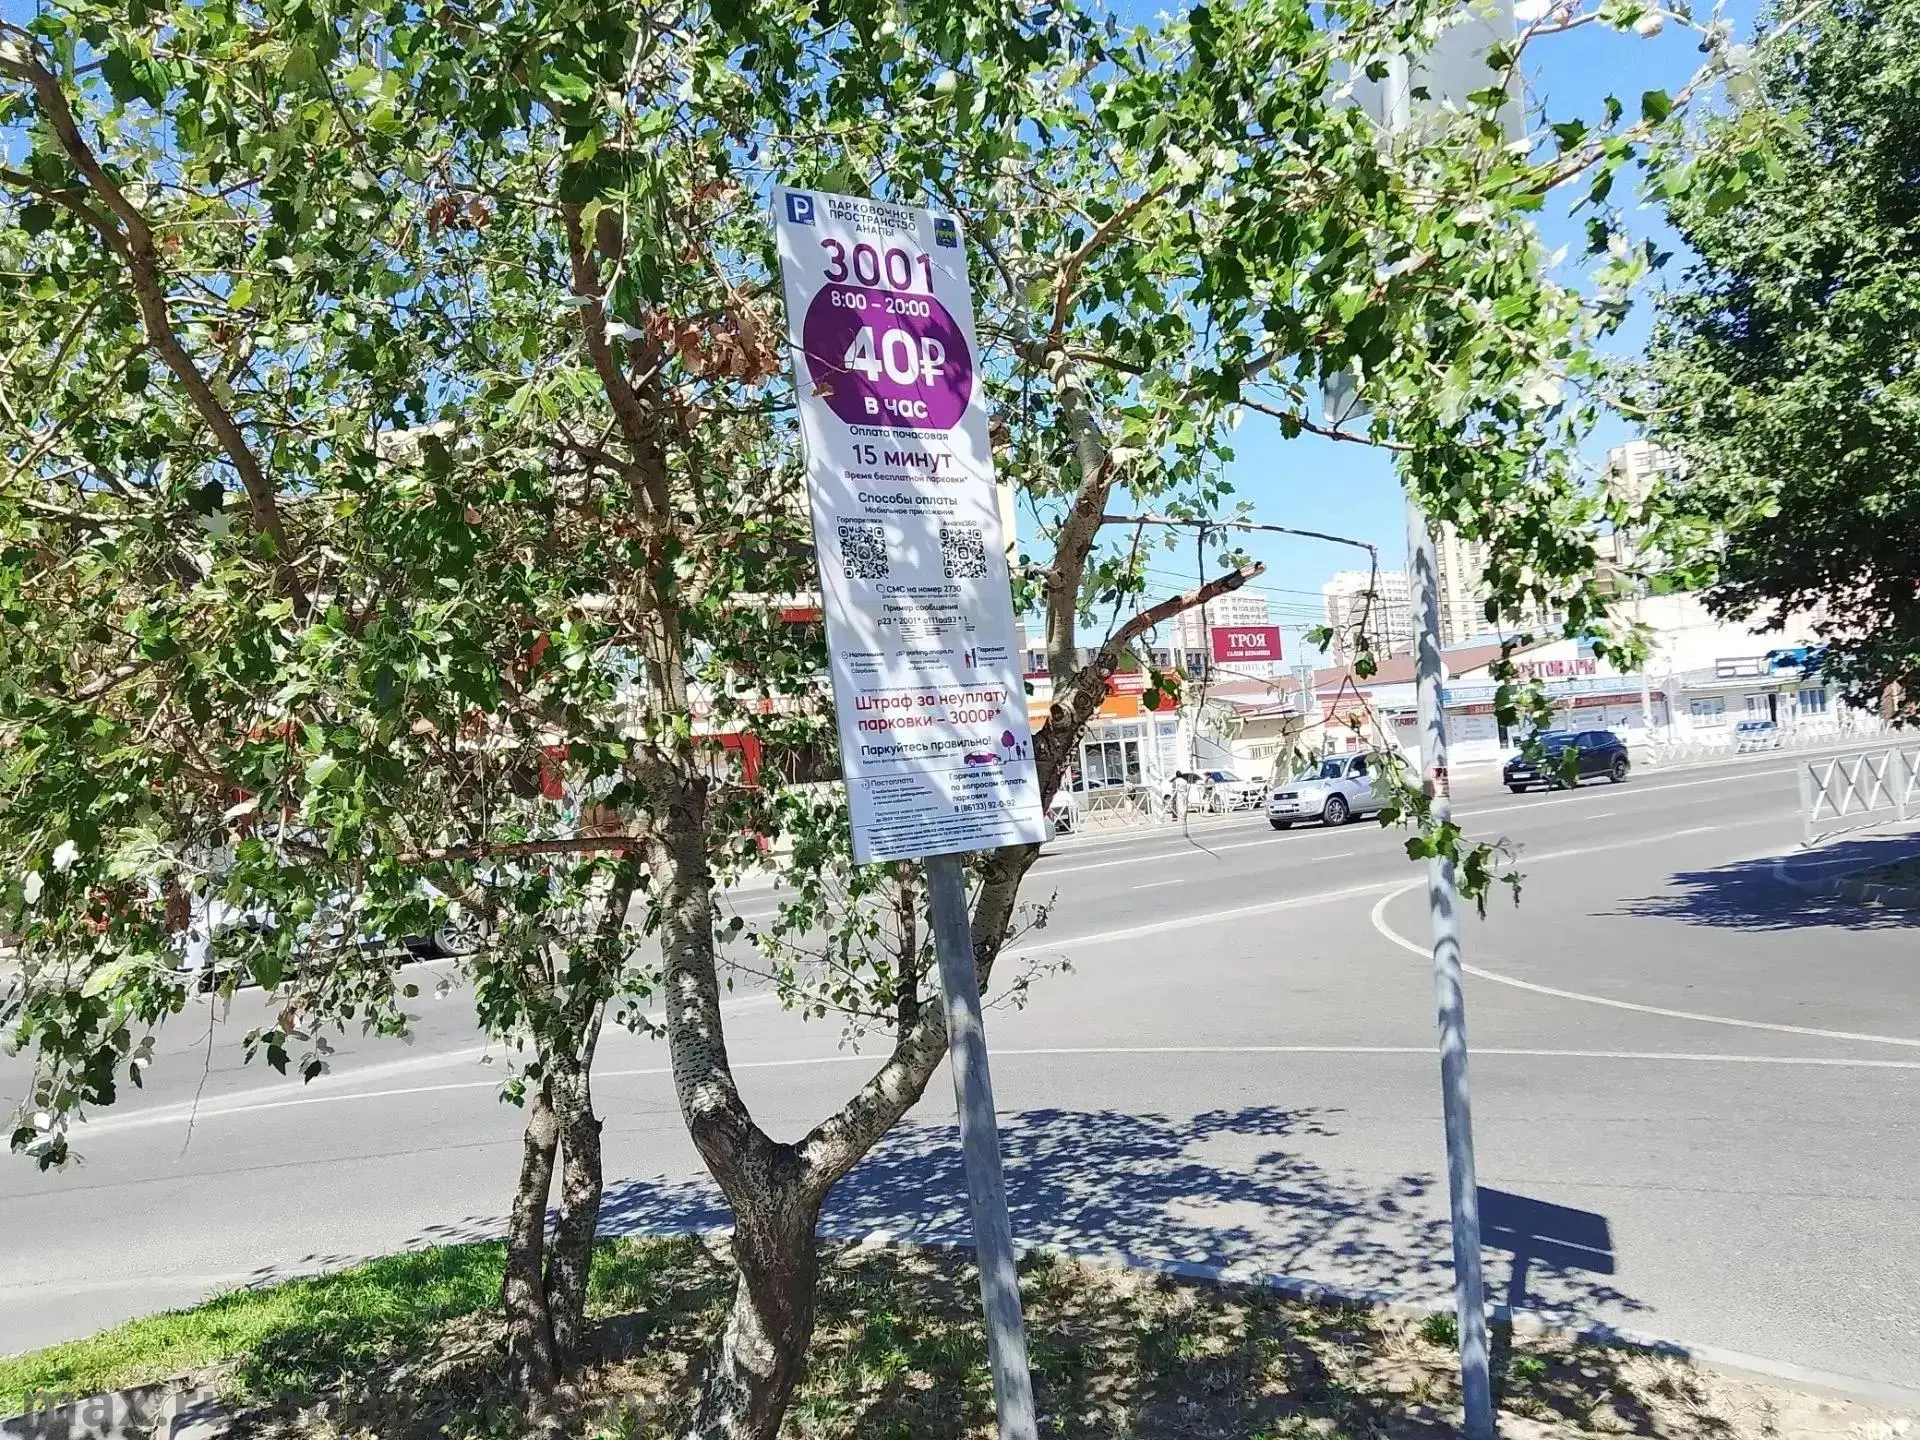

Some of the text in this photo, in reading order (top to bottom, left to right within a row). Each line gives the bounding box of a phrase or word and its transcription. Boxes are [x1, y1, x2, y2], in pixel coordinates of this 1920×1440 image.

[828, 199, 915, 222] ПАРКОВОЧНОЕ
[829, 210, 917, 232] ПРОСТРАНСТВО
[855, 224, 895, 238] АНАПЫ
[820, 238, 935, 294] 3001
[830, 290, 868, 310] 8:00
[884, 297, 931, 318] 20:00
[844, 325, 947, 387] 40₽
[863, 396, 929, 419] в час
[849, 425, 949, 442] Оплата почасовая
[851, 443, 953, 474] 15 минут
[845, 470, 873, 482] Время
[874, 472, 925, 484] бесплатной
[858, 492, 958, 507] Способы оплаты
[864, 506, 955, 517] Мобильное приложение
[836, 515, 884, 525] Горпарковки
[886, 584, 962, 595] СМС на номер 2730
[883, 603, 959, 614] Пример сообщения
[1227, 633, 1267, 648] ТРОЯ
[855, 690, 1008, 712] Штраф за неуплату
[858, 716, 933, 734] парковки
[861, 736, 992, 757] Паркуйтесь правильно!
[870, 777, 914, 787] Постоплата
[949, 772, 980, 782] Горячая
[950, 777, 1028, 792] по вопросам оплаты
[952, 792, 989, 803] парковки
[954, 805, 960, 813] 8
